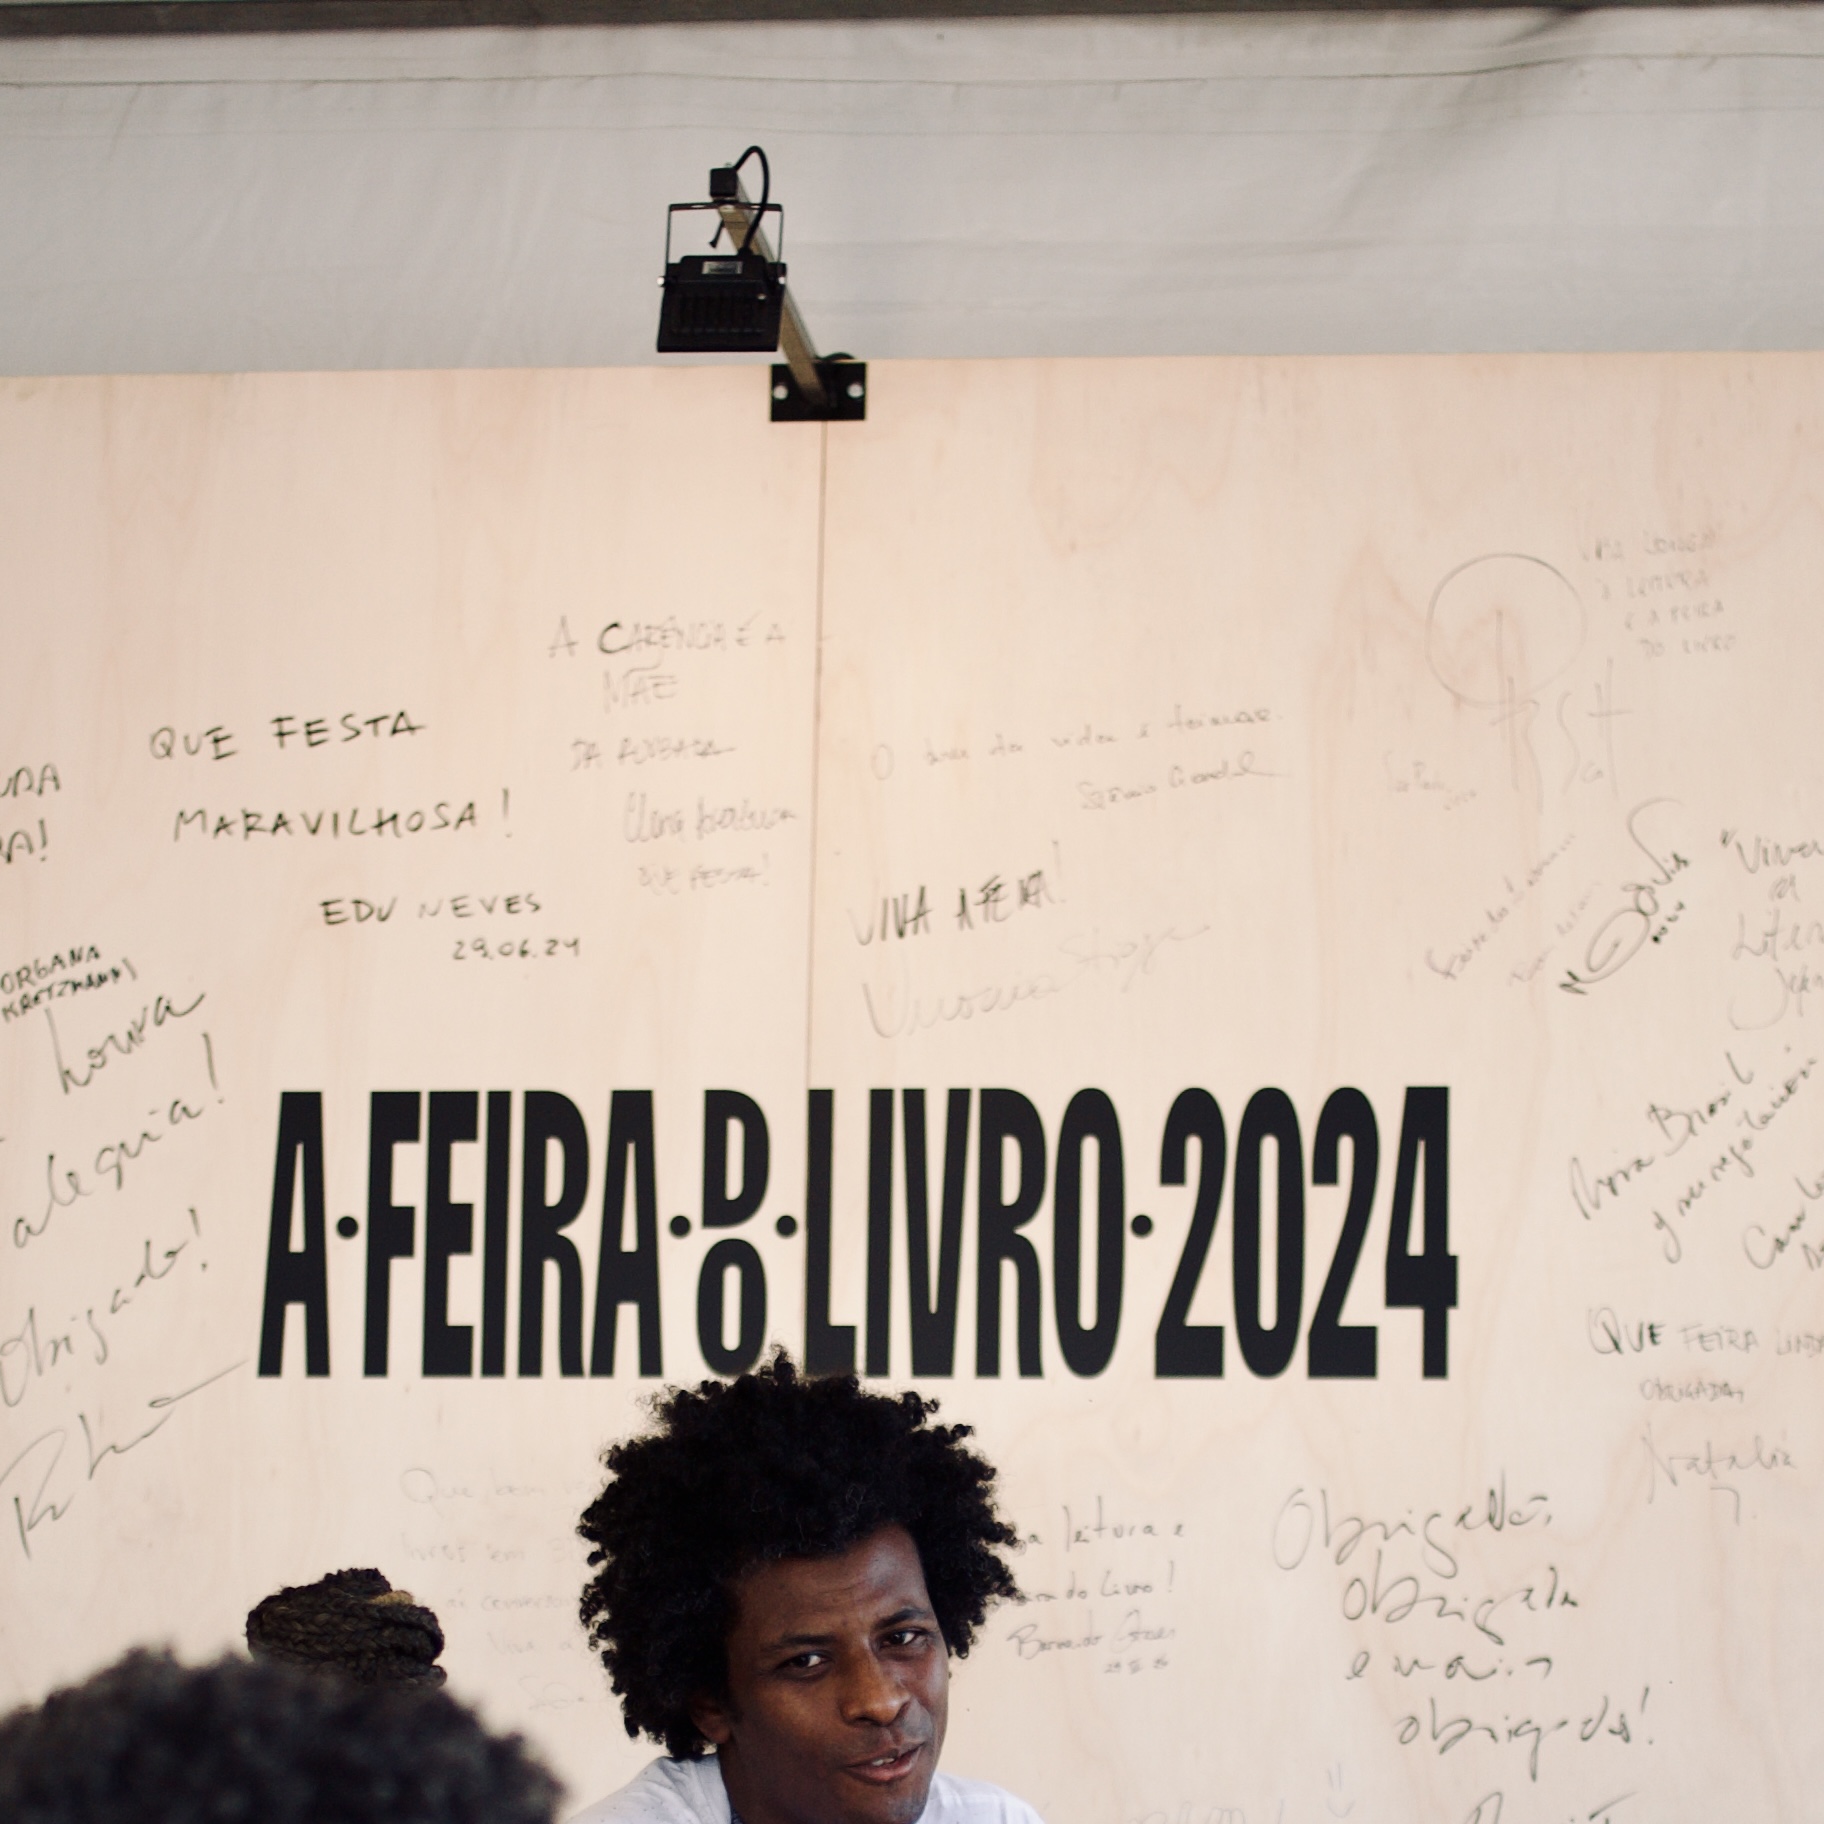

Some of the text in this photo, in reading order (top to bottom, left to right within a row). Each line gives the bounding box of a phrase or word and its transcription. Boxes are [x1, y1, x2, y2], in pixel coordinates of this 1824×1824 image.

[150, 709, 428, 761] QUE FESTA
[320, 893, 543, 926] EDU NEVES
[846, 882, 933, 946] VIVA
[257, 1089, 332, 1379] A
[363, 1089, 666, 1379] FEIRA
[695, 1087, 773, 1374] DO
[806, 1086, 1127, 1379] LIVRO
[1154, 1085, 1460, 1380] 2024
[1587, 1306, 1667, 1357] QUE
